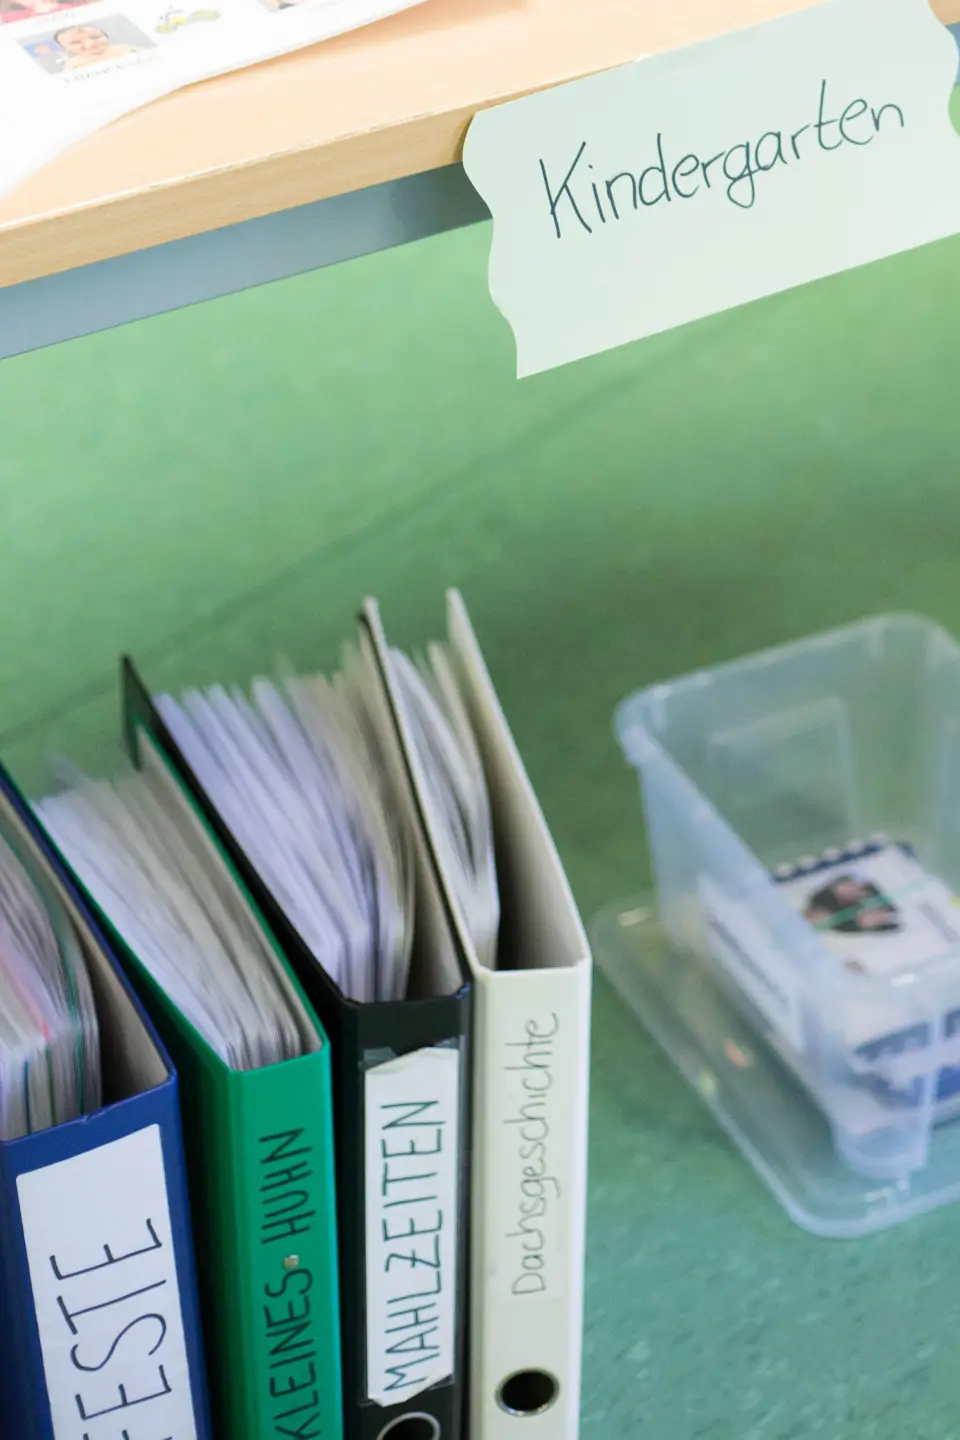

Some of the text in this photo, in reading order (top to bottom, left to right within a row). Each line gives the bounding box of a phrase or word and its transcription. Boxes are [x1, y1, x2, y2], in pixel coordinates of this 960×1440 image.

[539, 79, 905, 239] Kindergarten
[259, 1127, 321, 1440] KLEINES HUHN
[380, 1100, 447, 1392] MAHLZEITEN
[503, 1012, 561, 1296] Dachsgeschichte
